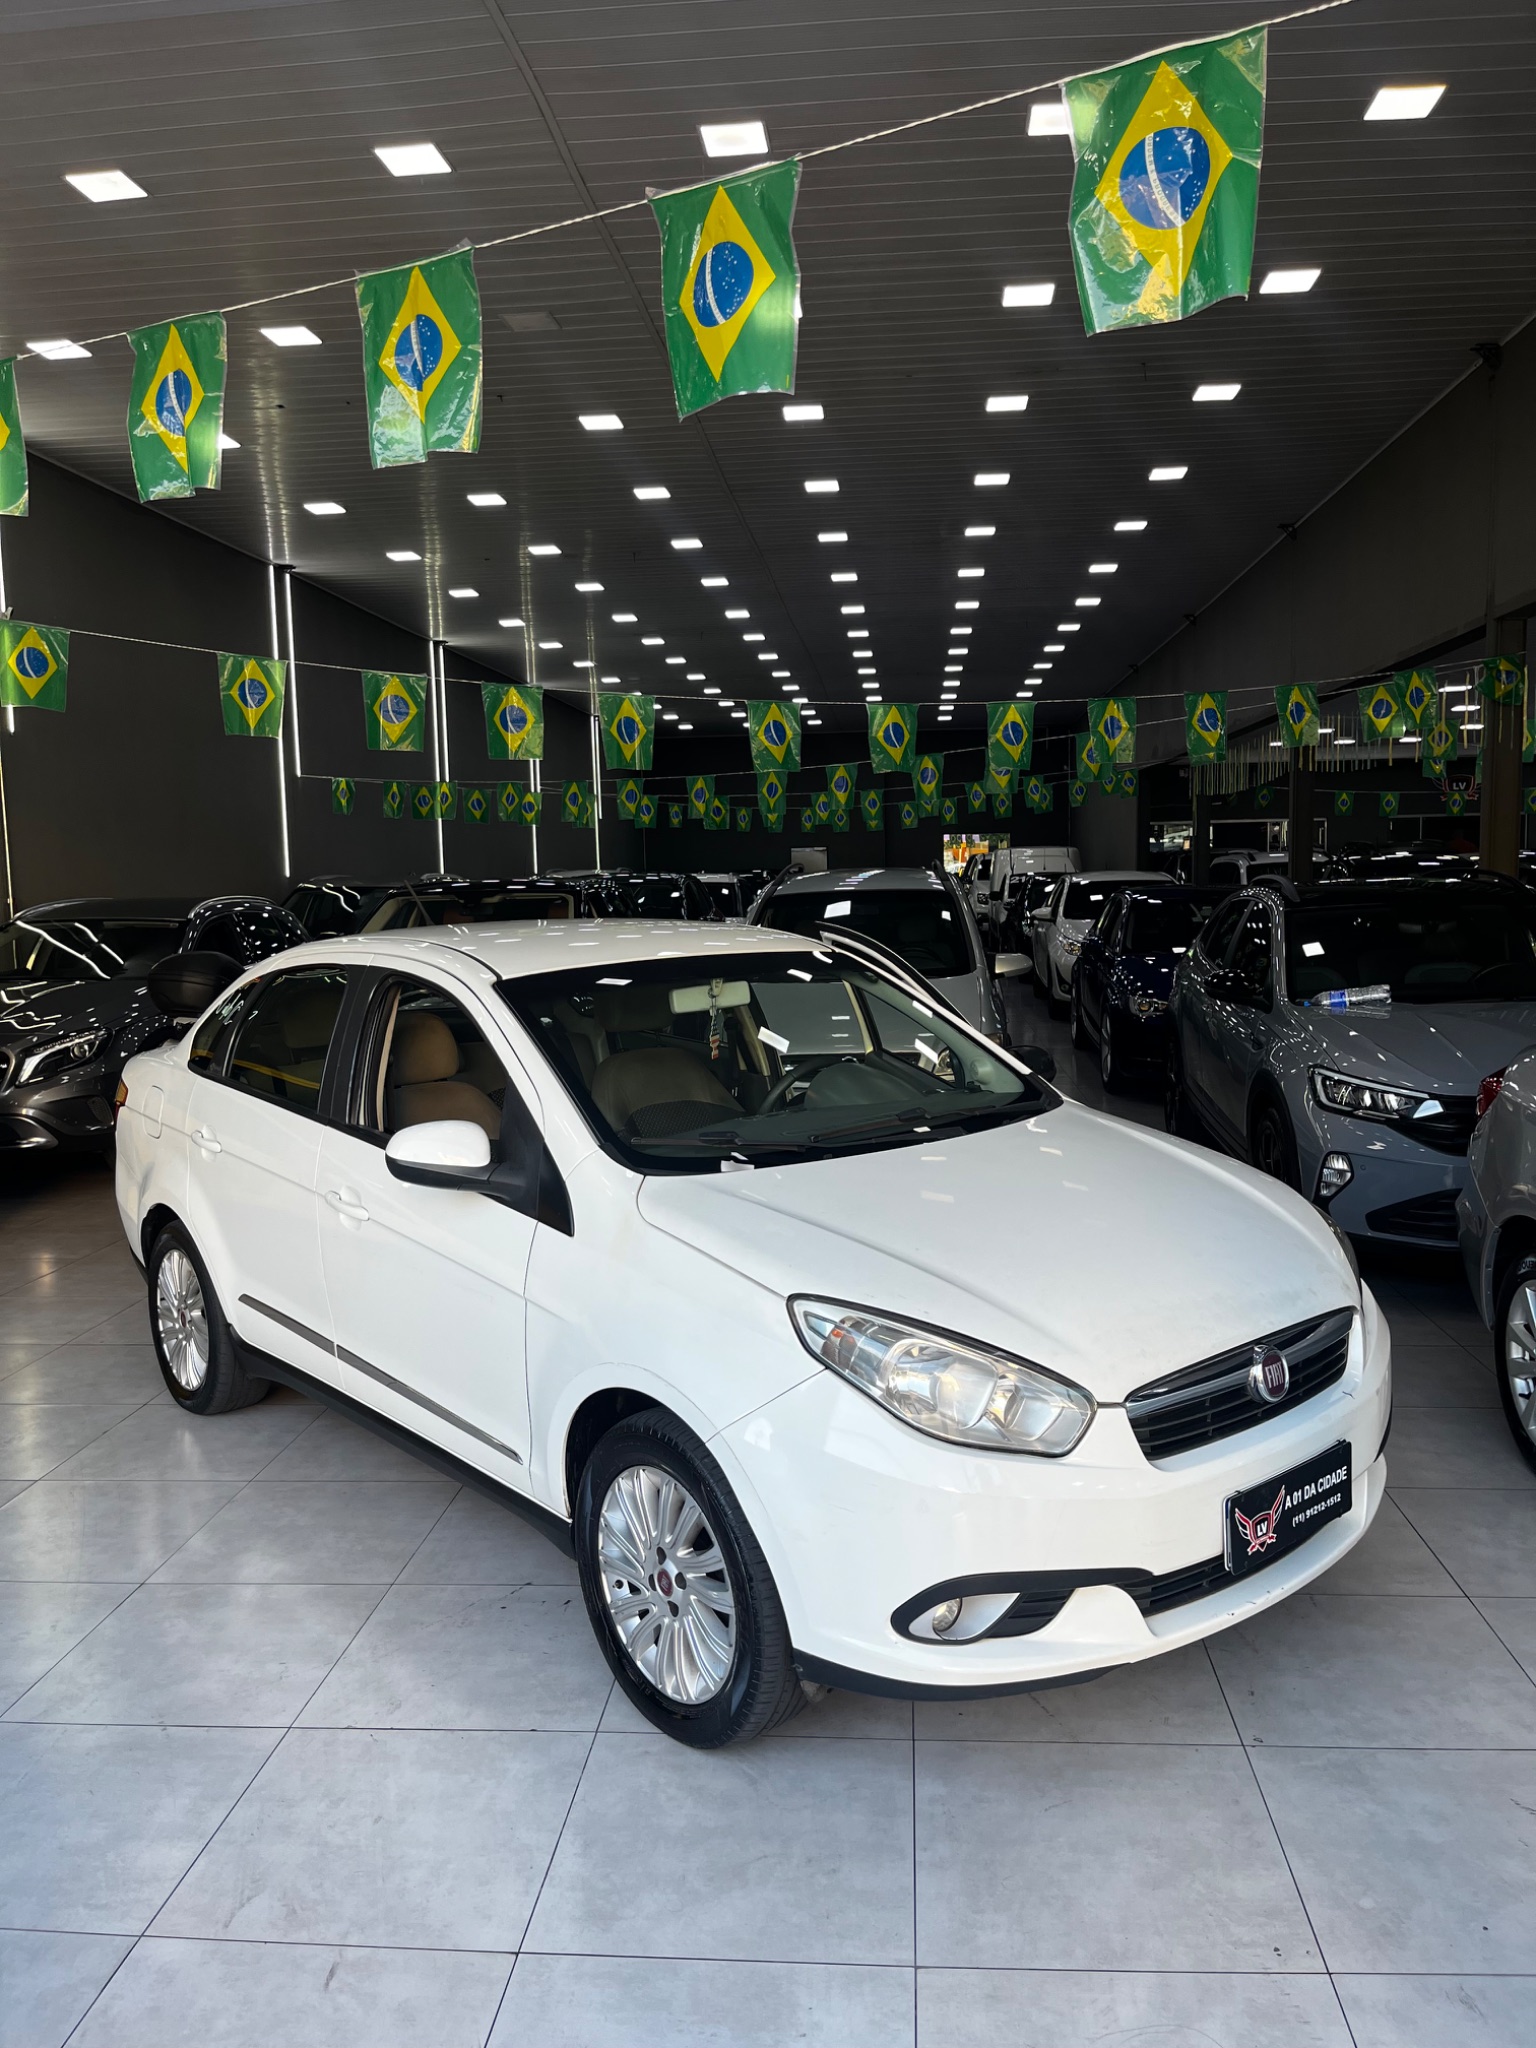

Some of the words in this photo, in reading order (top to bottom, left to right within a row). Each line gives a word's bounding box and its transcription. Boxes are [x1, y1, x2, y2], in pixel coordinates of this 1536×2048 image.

[1453, 782, 1466, 790] LV
[1265, 1362, 1284, 1388] FIAT
[1285, 1496, 1292, 1510] A
[1292, 1488, 1302, 1505] 01
[1303, 1485, 1317, 1501] DA
[1317, 1466, 1348, 1492] CIDADE
[1292, 1512, 1306, 1527] (11)
[1257, 1521, 1268, 1536] LV
